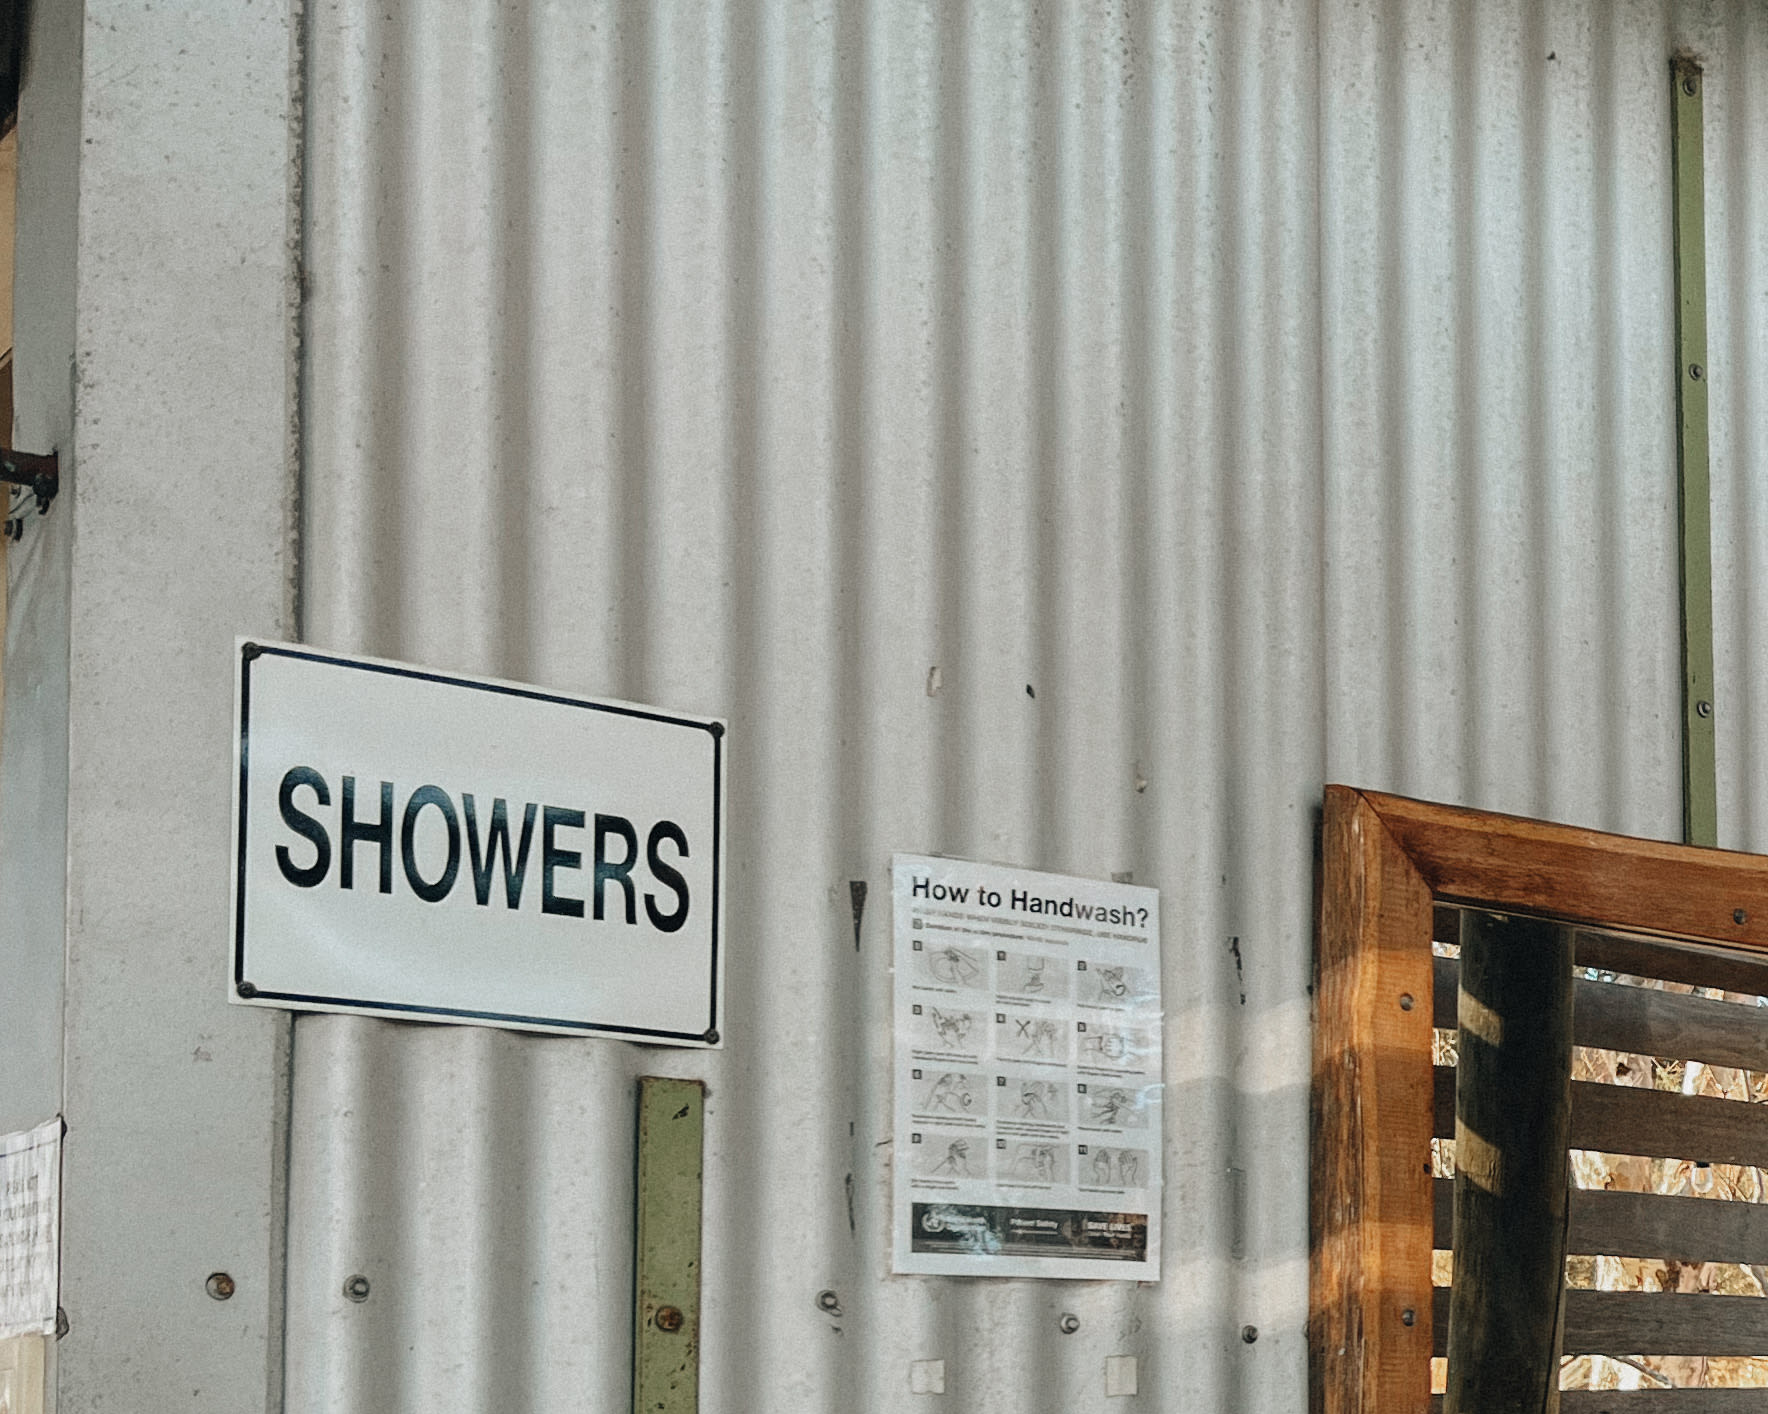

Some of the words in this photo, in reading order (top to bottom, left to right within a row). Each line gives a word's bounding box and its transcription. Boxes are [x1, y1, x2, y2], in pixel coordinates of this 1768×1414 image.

[274, 765, 691, 934] SHOWERS
[911, 876, 969, 905] How
[977, 884, 1002, 908] to
[1010, 888, 1149, 929] Handwash?
